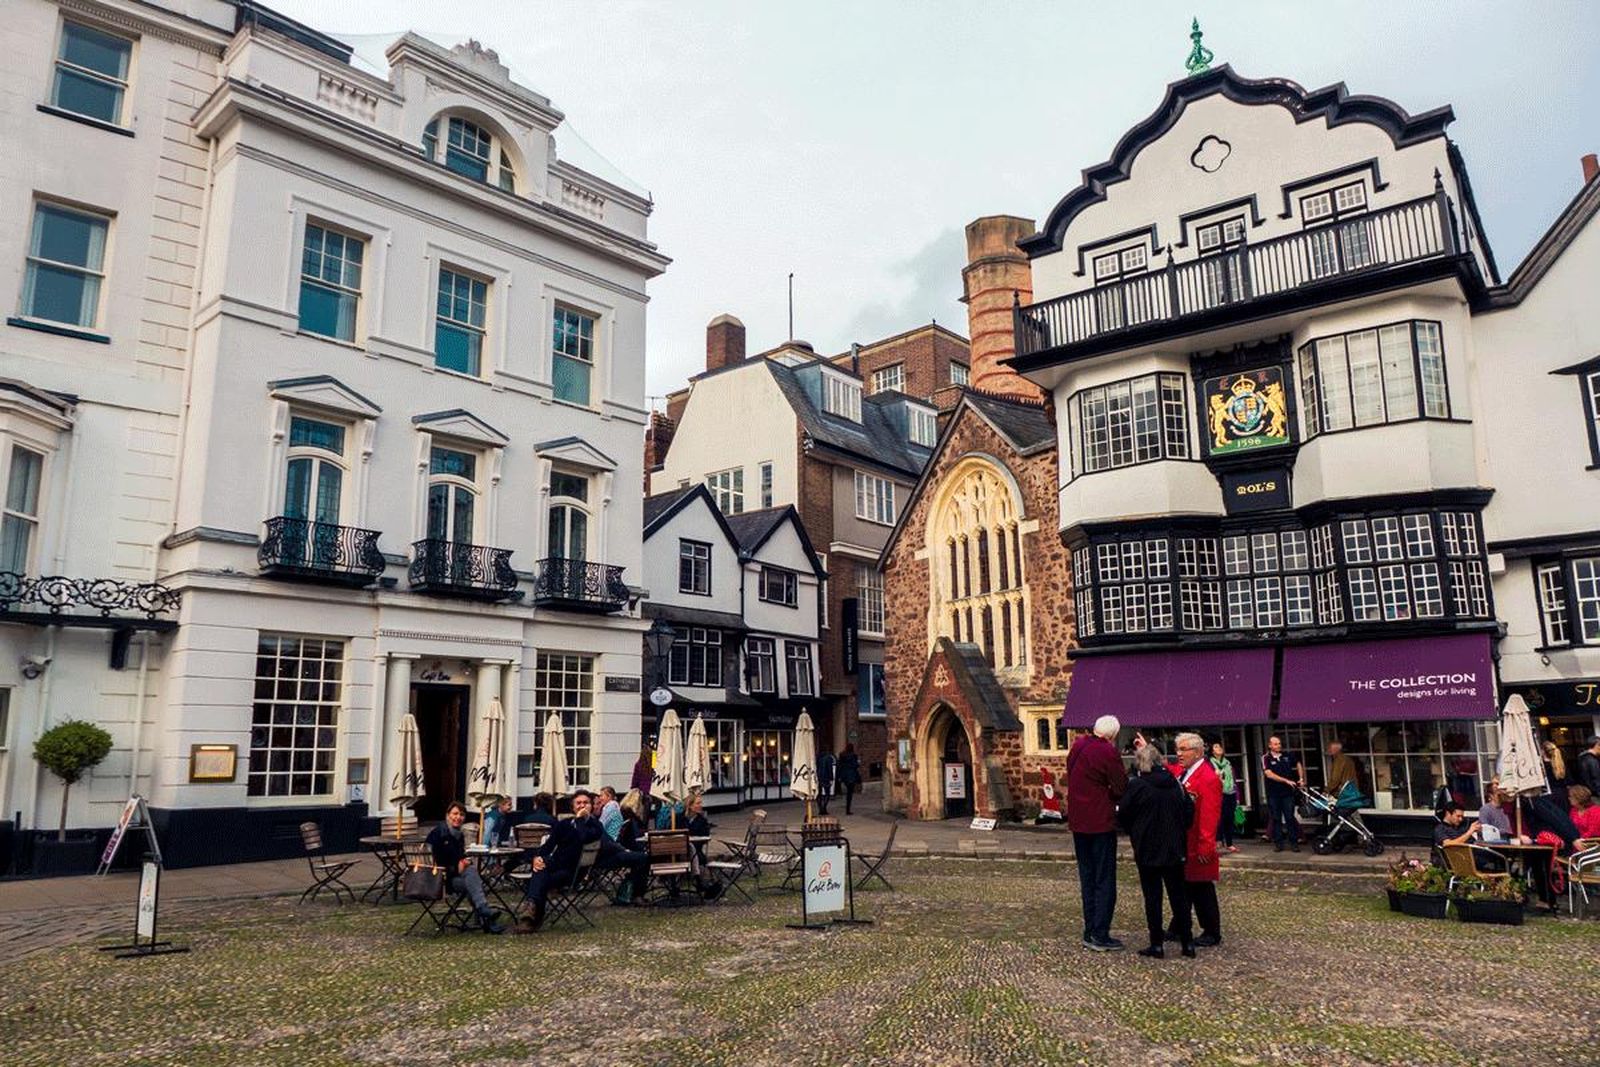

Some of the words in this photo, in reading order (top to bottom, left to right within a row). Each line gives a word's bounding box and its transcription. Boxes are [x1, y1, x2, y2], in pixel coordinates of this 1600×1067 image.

[1236, 438, 1262, 449] 1596
[1349, 680, 1376, 690] THE
[1379, 673, 1476, 689] COLLECTION
[1397, 689, 1432, 699] designs
[1434, 687, 1448, 696] for
[1450, 686, 1477, 697] living
